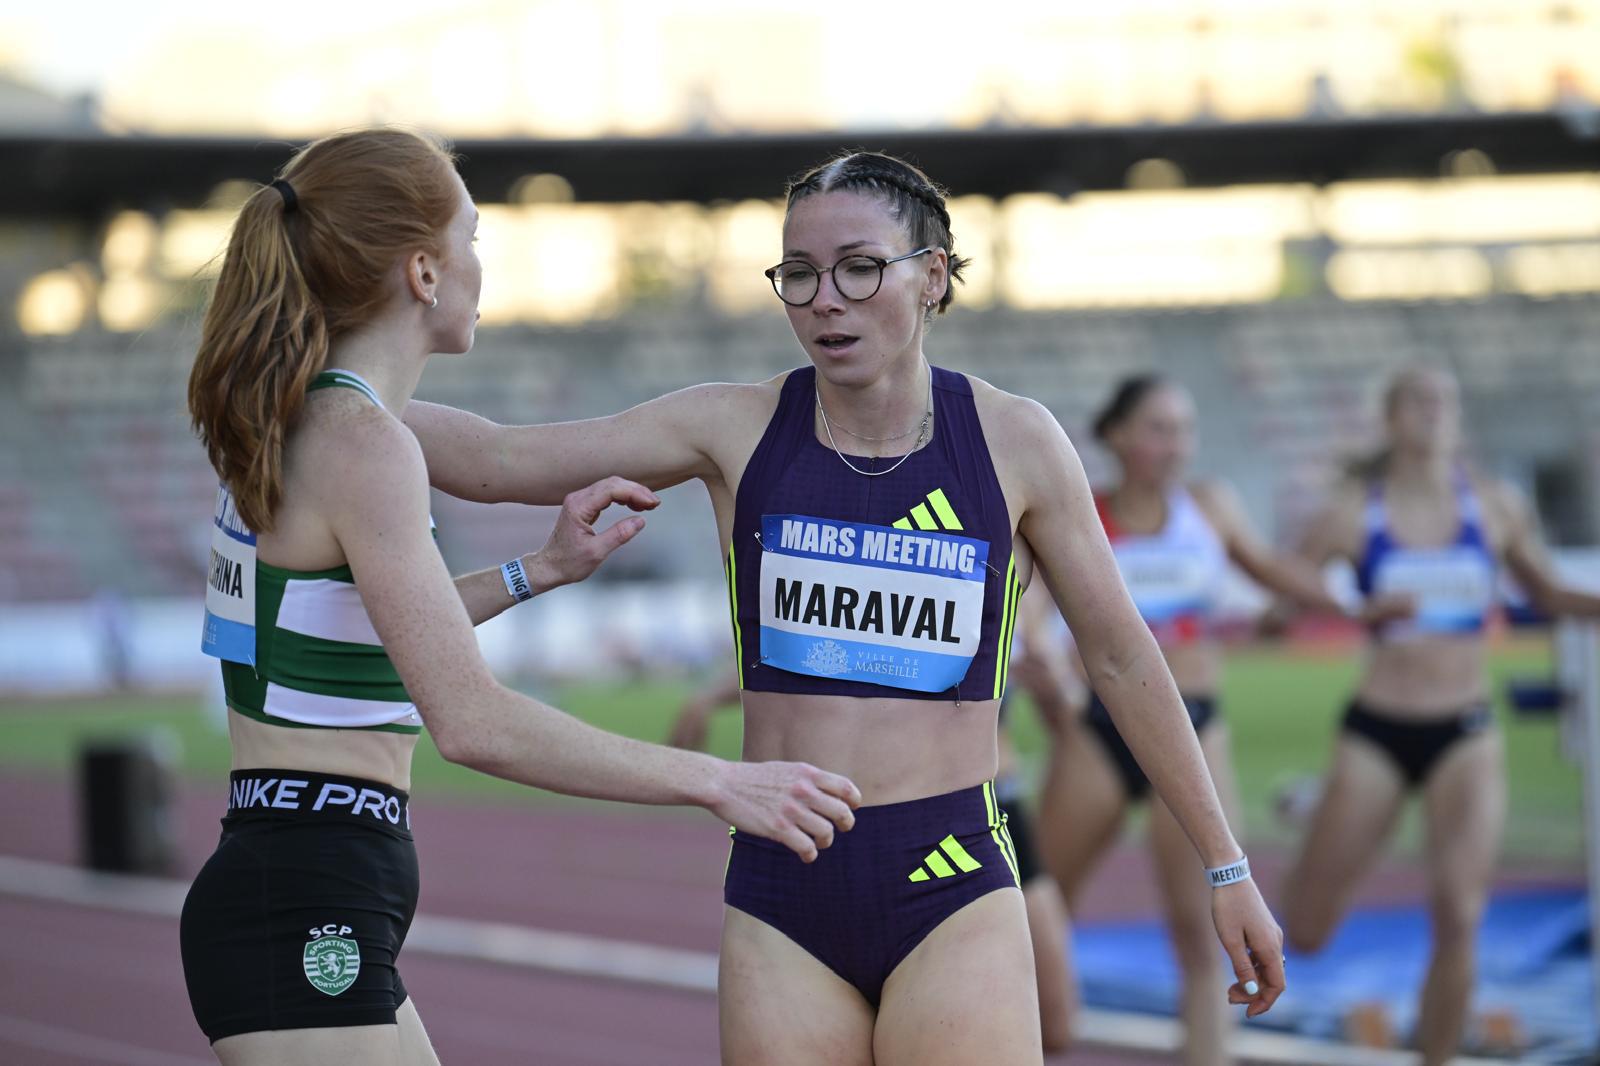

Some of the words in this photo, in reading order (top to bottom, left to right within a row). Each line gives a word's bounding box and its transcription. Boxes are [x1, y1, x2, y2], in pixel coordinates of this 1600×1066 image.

[780, 519, 856, 557] MARS
[861, 530, 976, 574] MEETING
[774, 577, 961, 644] MARAVAL
[858, 651, 895, 663] VILLE
[904, 658, 919, 666] DE
[855, 661, 919, 679] MARSEILLE
[232, 778, 309, 809] NIKE
[312, 783, 400, 825] PRO
[308, 923, 353, 939] SCP
[309, 940, 354, 956] SPORTING
[313, 976, 353, 989] PORTUGAL
